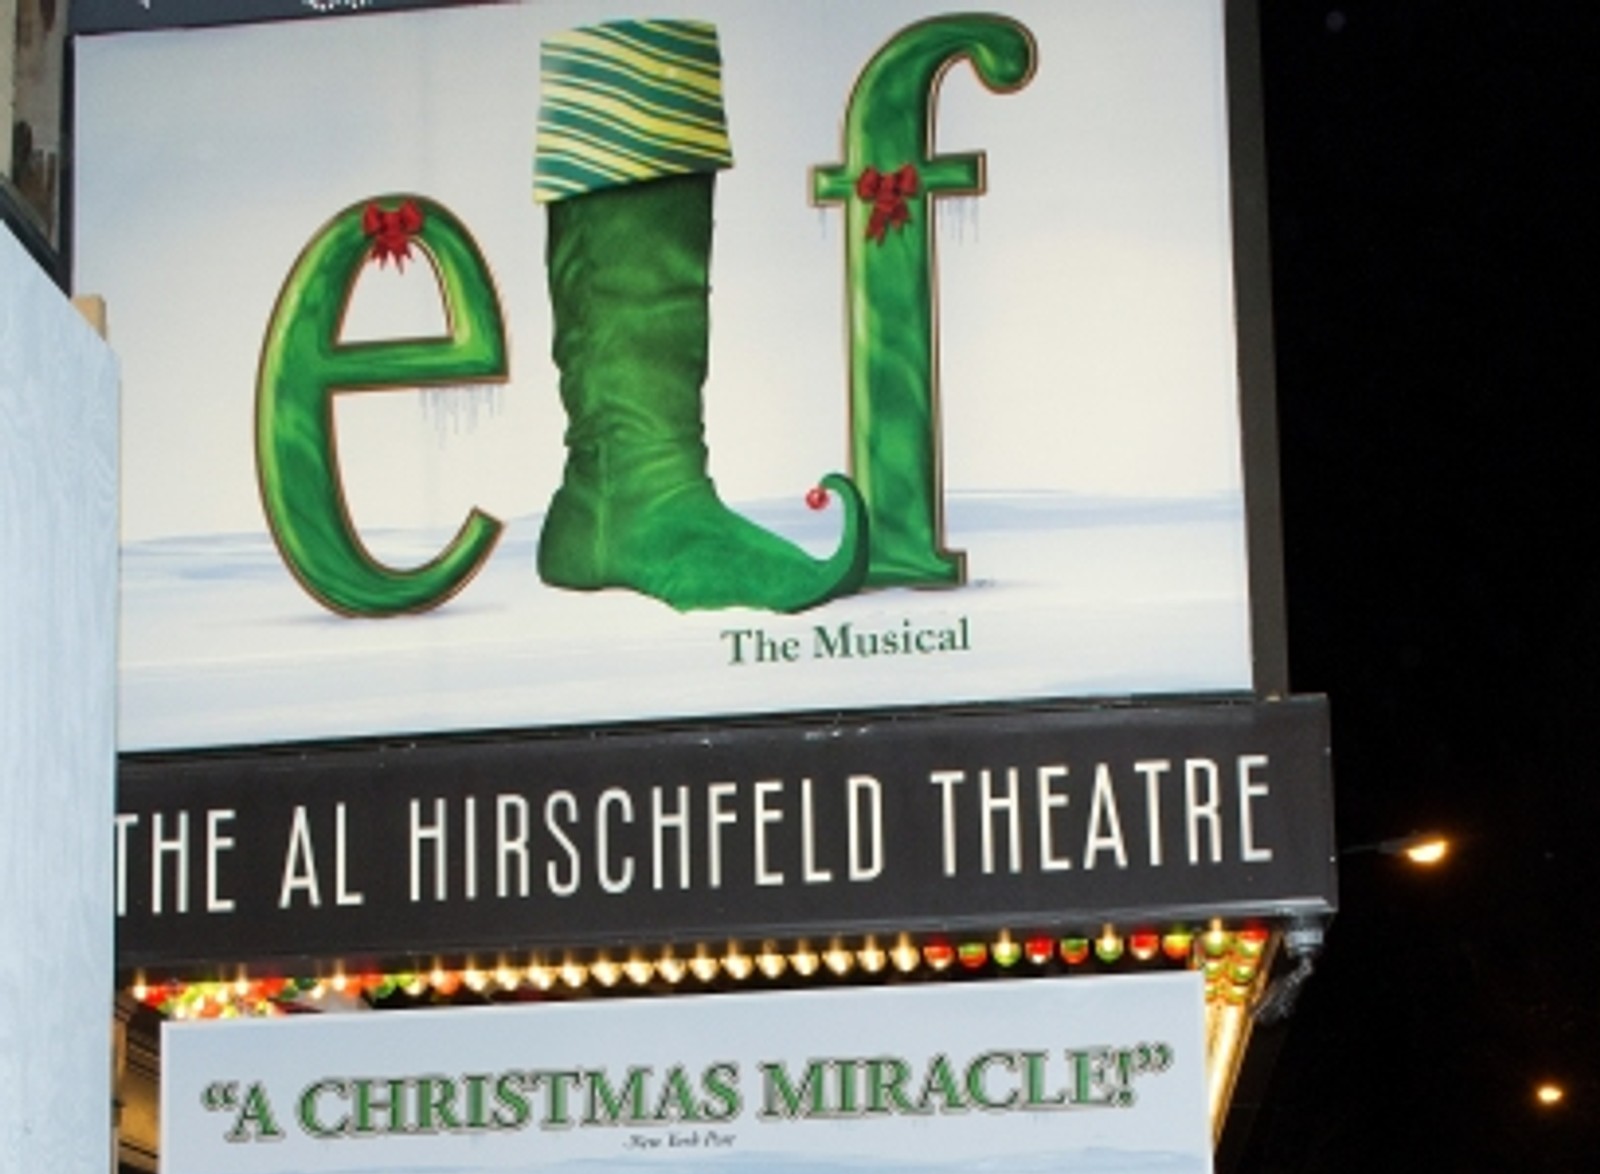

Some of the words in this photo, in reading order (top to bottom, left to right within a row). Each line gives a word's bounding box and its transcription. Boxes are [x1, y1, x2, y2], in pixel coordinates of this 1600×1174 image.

[720, 628, 800, 665] The
[813, 616, 971, 658] Musical
[115, 810, 236, 917] THE
[279, 803, 364, 908] AL
[410, 774, 884, 902] HIRSCHFELD
[930, 754, 1273, 877] THEATRE
[201, 1080, 285, 1143] “A
[296, 1062, 744, 1139] CHRISTMAS
[757, 1041, 1174, 1122] MIRACLE!”
